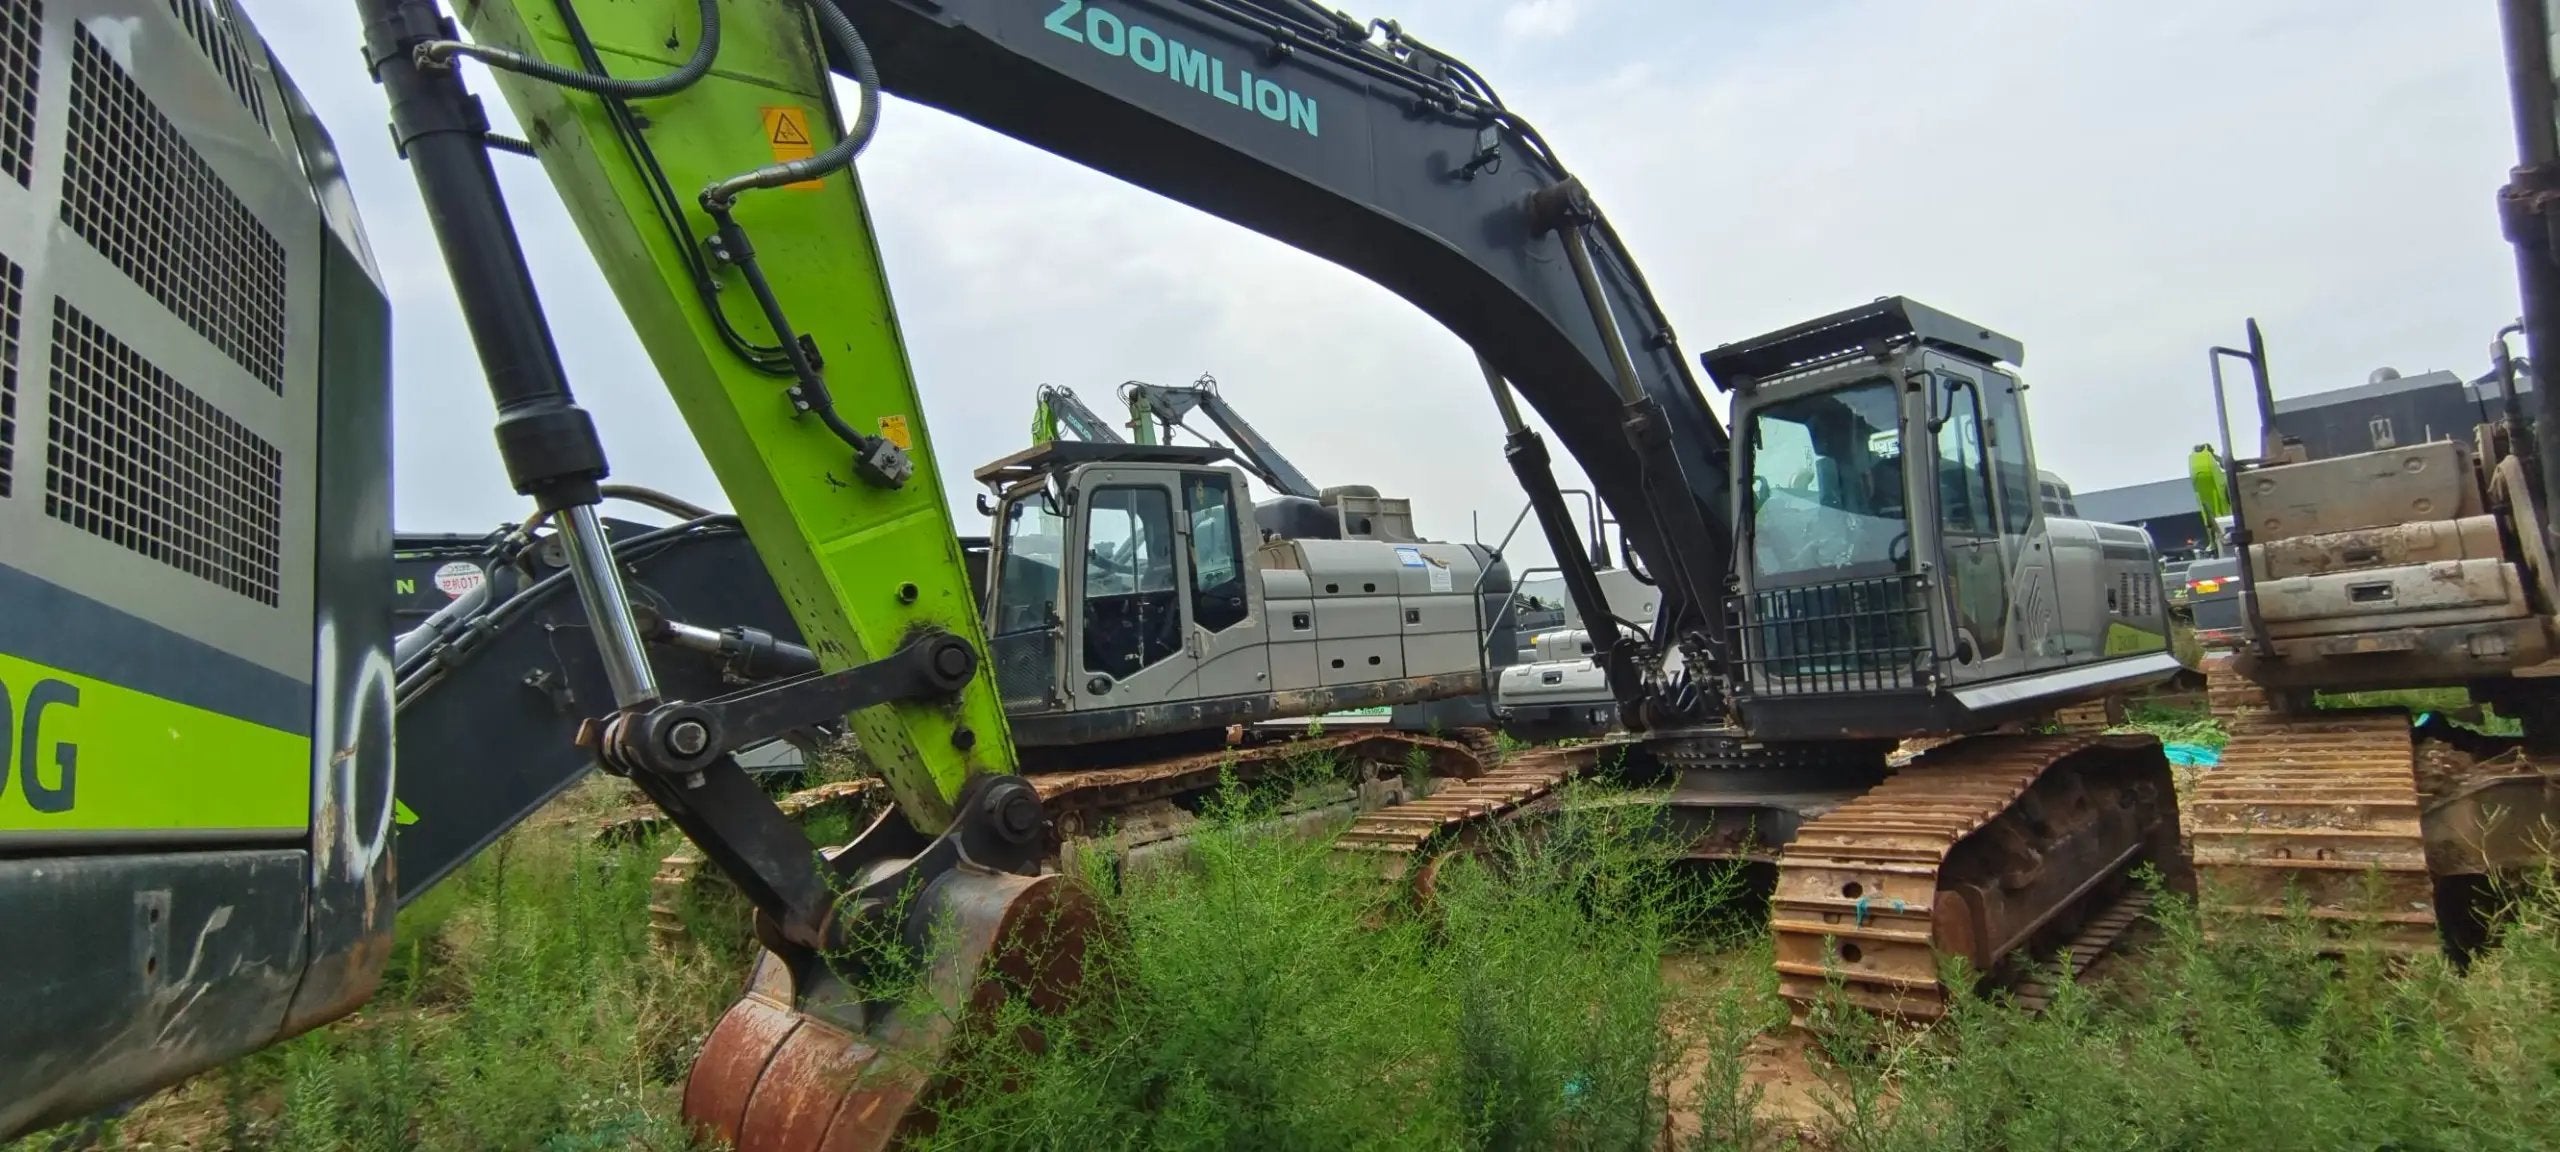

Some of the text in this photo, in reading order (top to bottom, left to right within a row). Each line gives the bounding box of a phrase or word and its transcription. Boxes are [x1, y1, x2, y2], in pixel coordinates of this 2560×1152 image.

[1044, 0, 1318, 137] ZOOMLION
[396, 579, 415, 594] N
[0, 677, 80, 813] G
